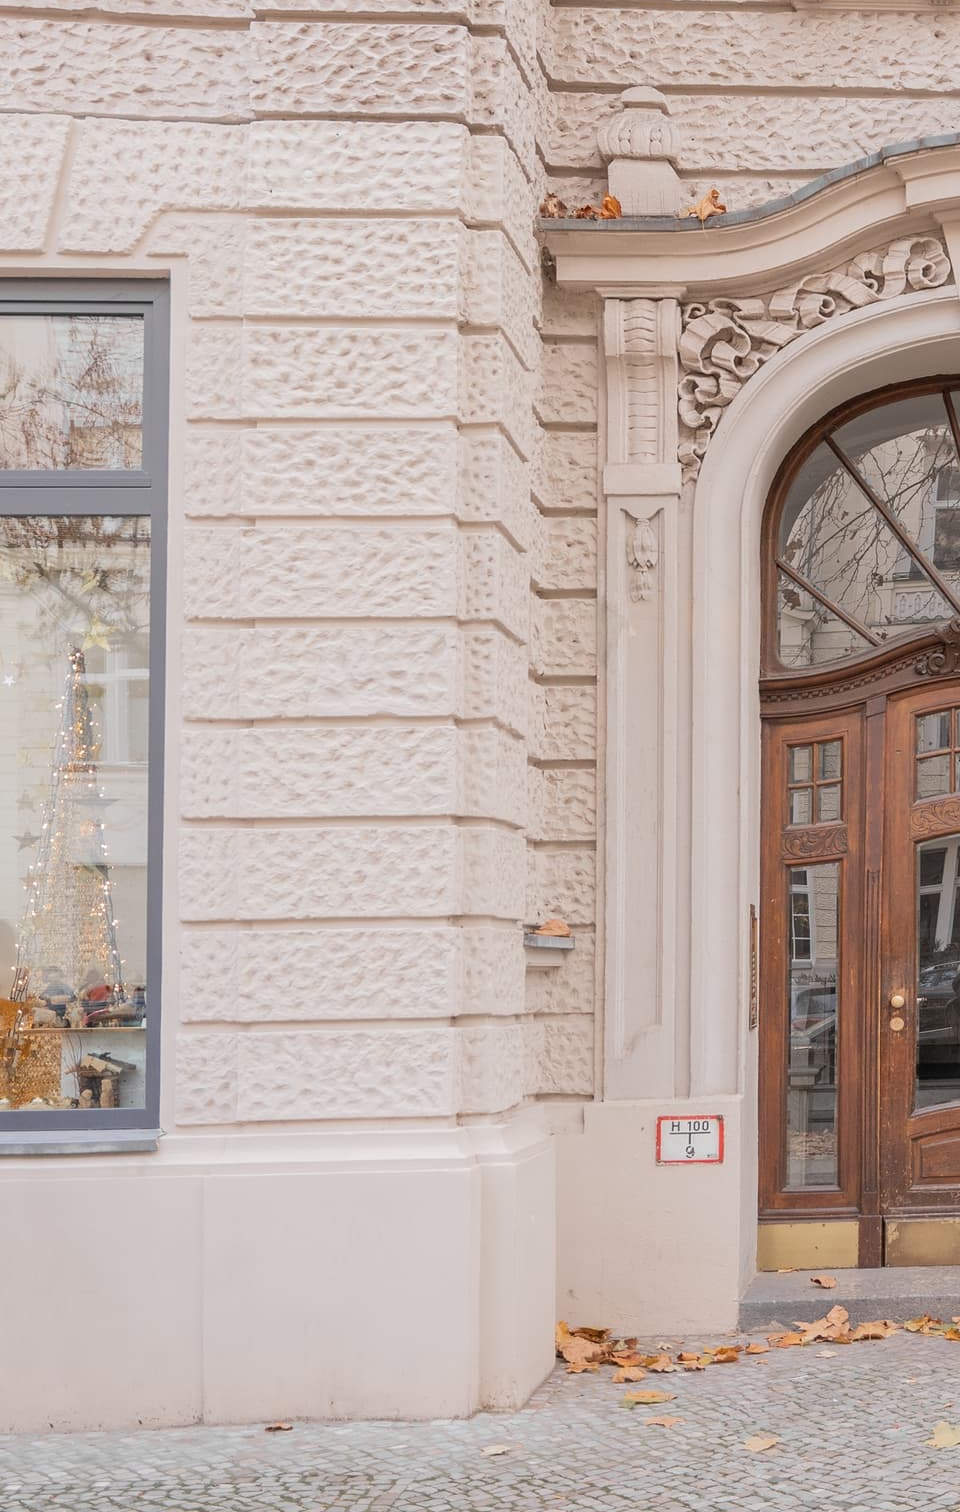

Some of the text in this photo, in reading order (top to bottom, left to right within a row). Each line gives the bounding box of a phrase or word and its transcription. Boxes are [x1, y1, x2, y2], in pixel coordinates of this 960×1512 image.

[671, 1120, 710, 1132] H 100
[685, 1145, 696, 1159] 9
